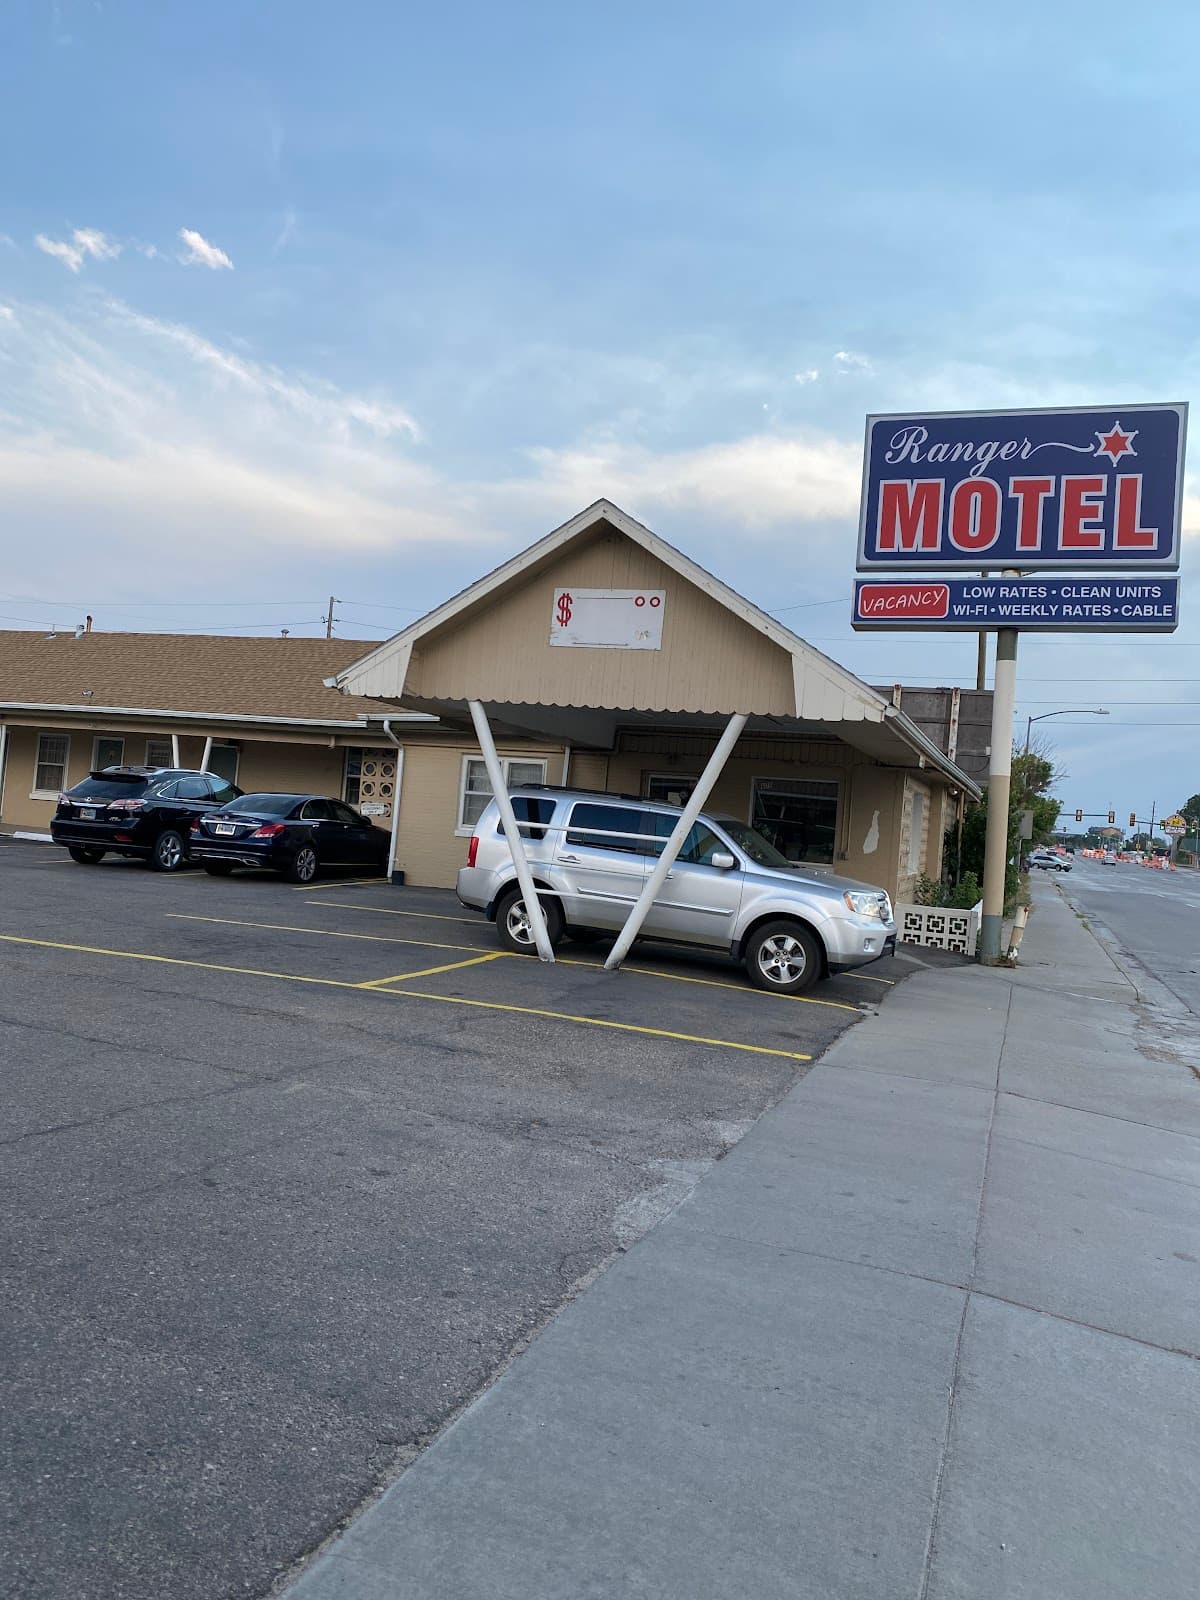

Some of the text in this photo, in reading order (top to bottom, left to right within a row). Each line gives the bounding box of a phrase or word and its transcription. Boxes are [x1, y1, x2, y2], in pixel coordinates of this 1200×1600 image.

[885, 425, 1036, 477] Ranger
[875, 473, 1159, 553] MOTEL
[863, 588, 945, 613] VACANCY
[963, 586, 1162, 598] LOW RATES CLEAN UNITS
[953, 604, 1173, 617] WI-FI WEEKLY RATES CABLE
